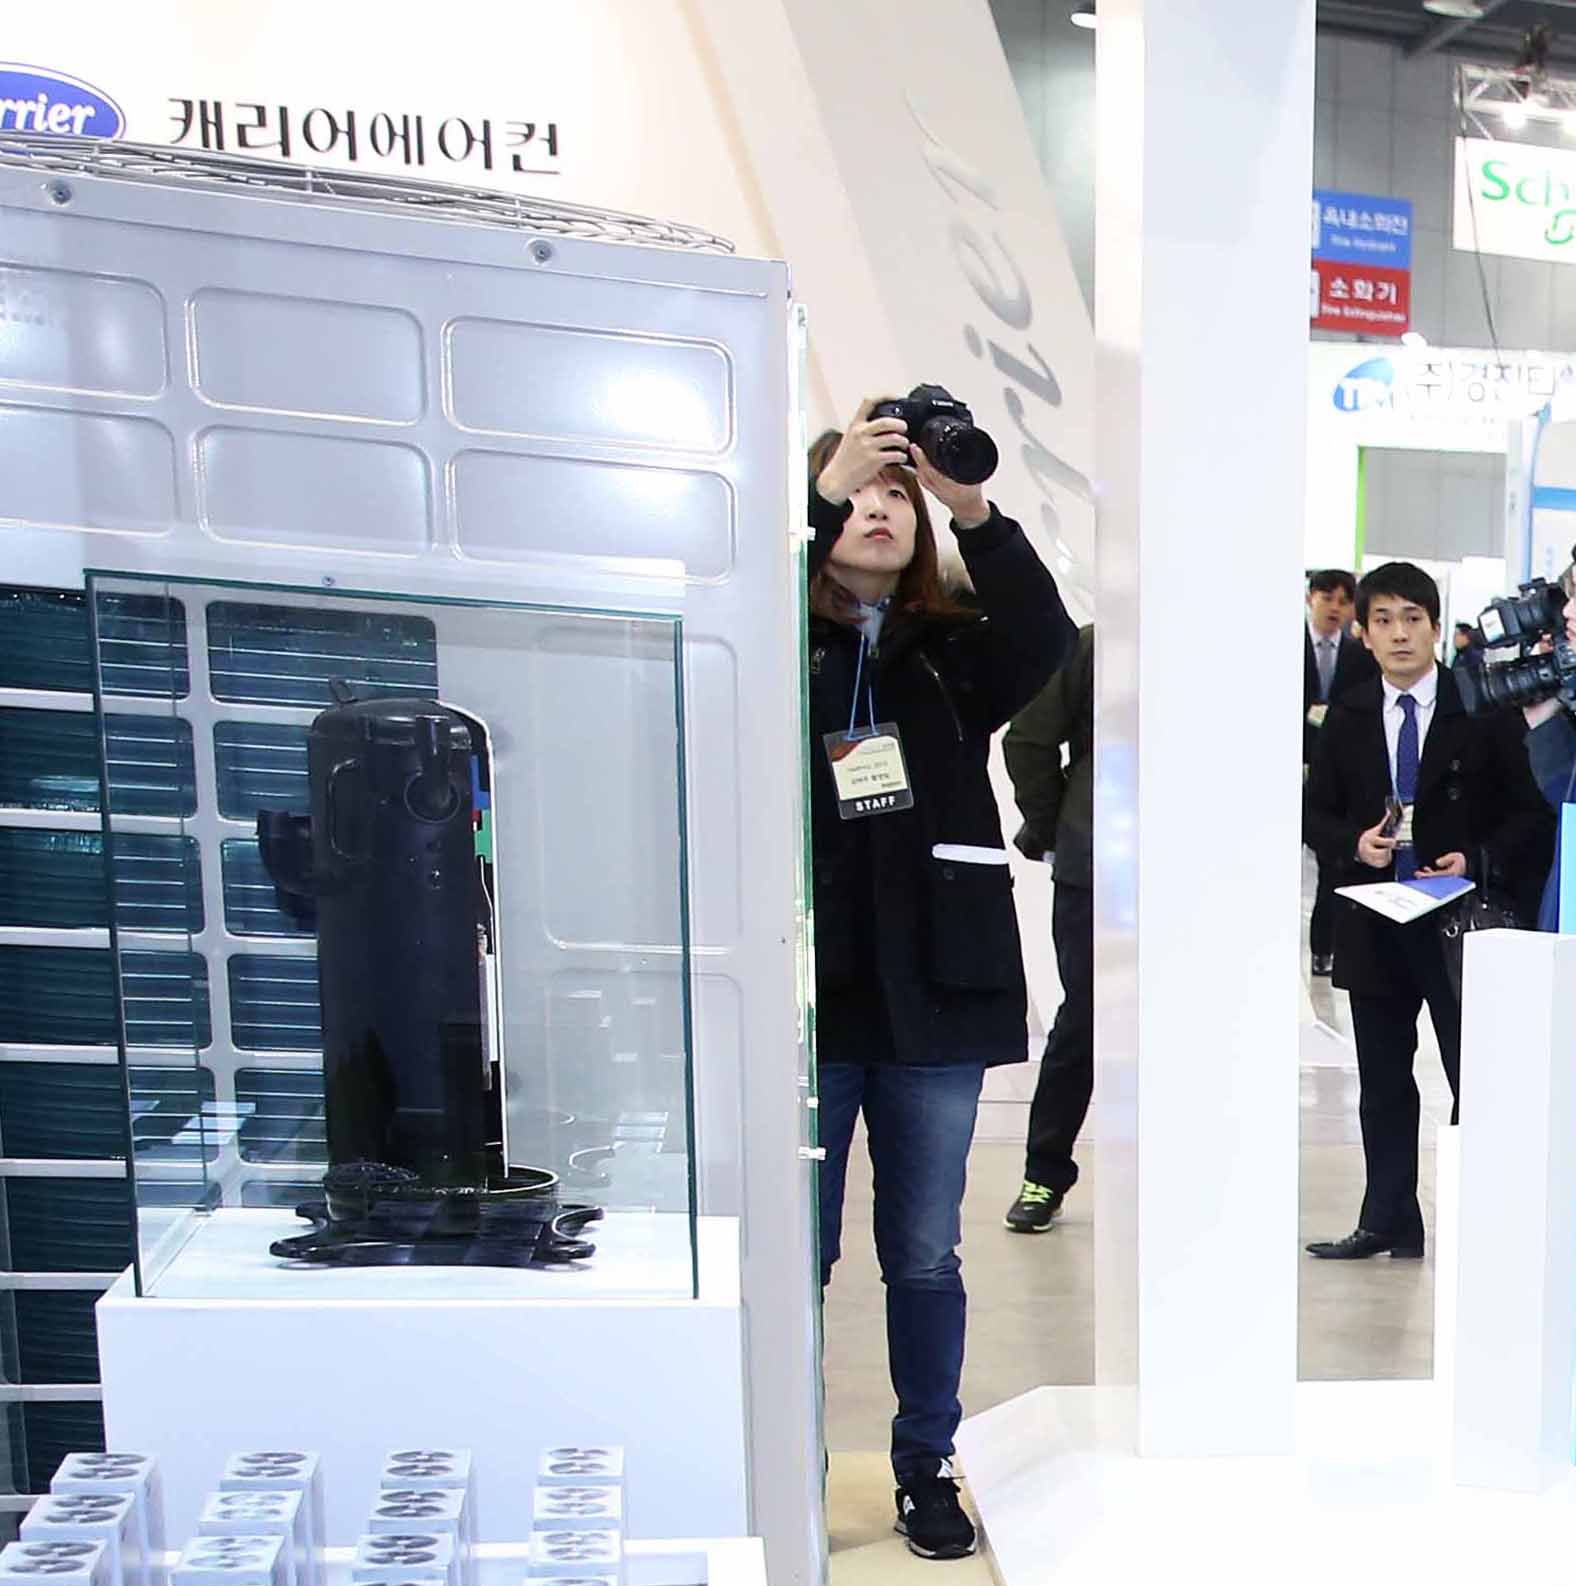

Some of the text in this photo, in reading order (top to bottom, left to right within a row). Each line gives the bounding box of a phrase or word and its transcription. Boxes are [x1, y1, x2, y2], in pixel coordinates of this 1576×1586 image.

[168, 97, 561, 176] 캐리어에어컨
[1329, 277, 1398, 305] 소화기
[855, 795, 896, 812] STAFF
